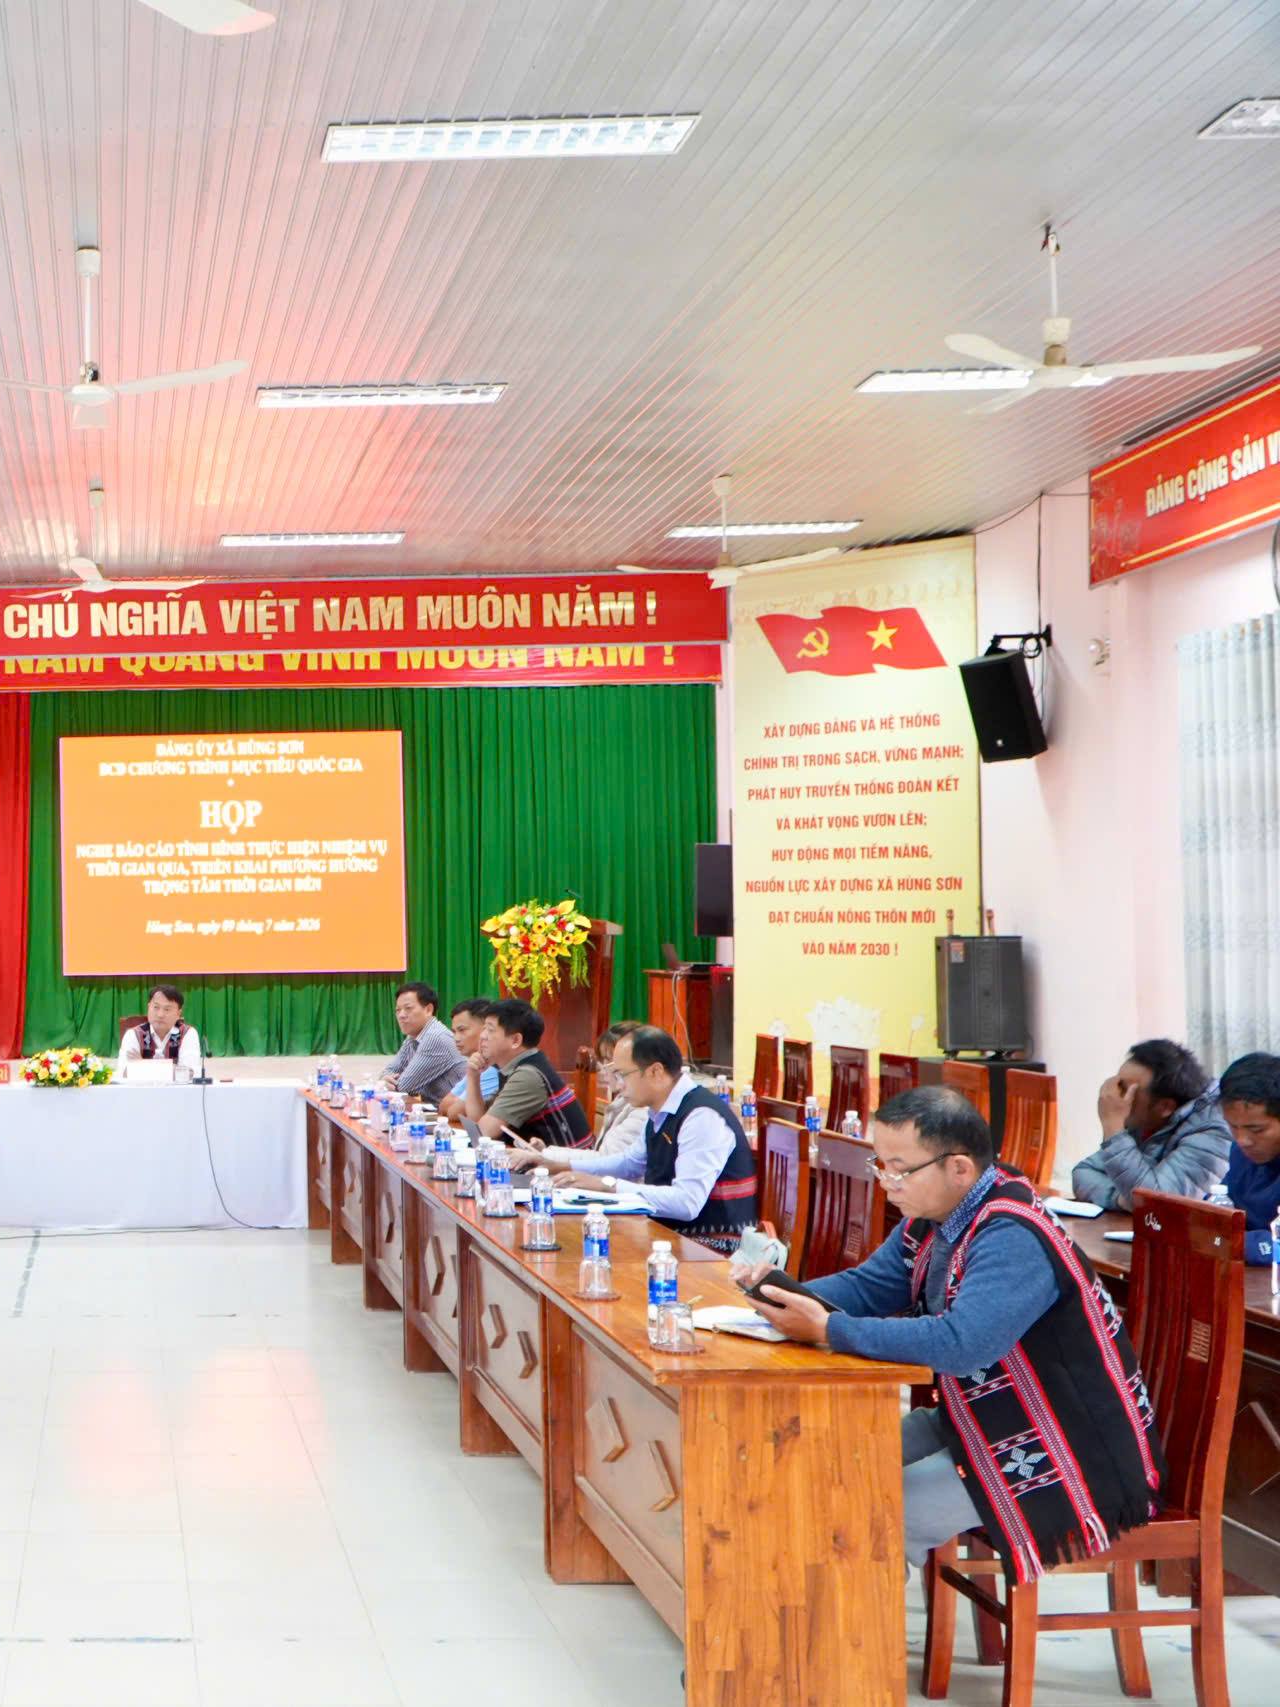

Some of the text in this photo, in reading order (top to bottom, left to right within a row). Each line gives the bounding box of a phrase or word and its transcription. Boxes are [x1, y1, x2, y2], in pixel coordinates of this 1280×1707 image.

[1146, 474, 1184, 517] ĐẢNG
[1187, 455, 1228, 502] CỘNG
[1231, 433, 1266, 481] SẢN
[4, 591, 79, 639] CHỦ
[90, 592, 208, 637] NGHĨA
[218, 590, 300, 640] VIỆT
[313, 596, 404, 632] NAM
[416, 586, 530, 630] MUÔN
[542, 584, 634, 627] NĂM
[646, 591, 656, 625] !
[764, 711, 940, 740] XÂY DỰNG ĐẢNG VÀ HỆ THỐNG
[744, 745, 964, 770] CHÍNH TRỊ TRONG SẠCH, VỮNG MẠNH;
[748, 775, 959, 801] PHÁT HUY TRUYỀN THỐNG ĐOÀN KẾT
[200, 800, 262, 834] HỌP
[776, 811, 927, 832] VÀ KHÁT VỌNG VƯƠN LÊN;
[772, 842, 932, 864] HUY ĐỘNG MỌI TIỀM NĂNG,
[746, 876, 962, 895] NGUỒN LỰC XÂY DỰNG XÃ HÙNG SƠN
[769, 906, 936, 926] ĐẠT CHUẨN NÔNG THÔN MỚI
[802, 940, 825, 955] VÀO
[829, 940, 856, 956] NĂM
[860, 943, 890, 956] 2030
